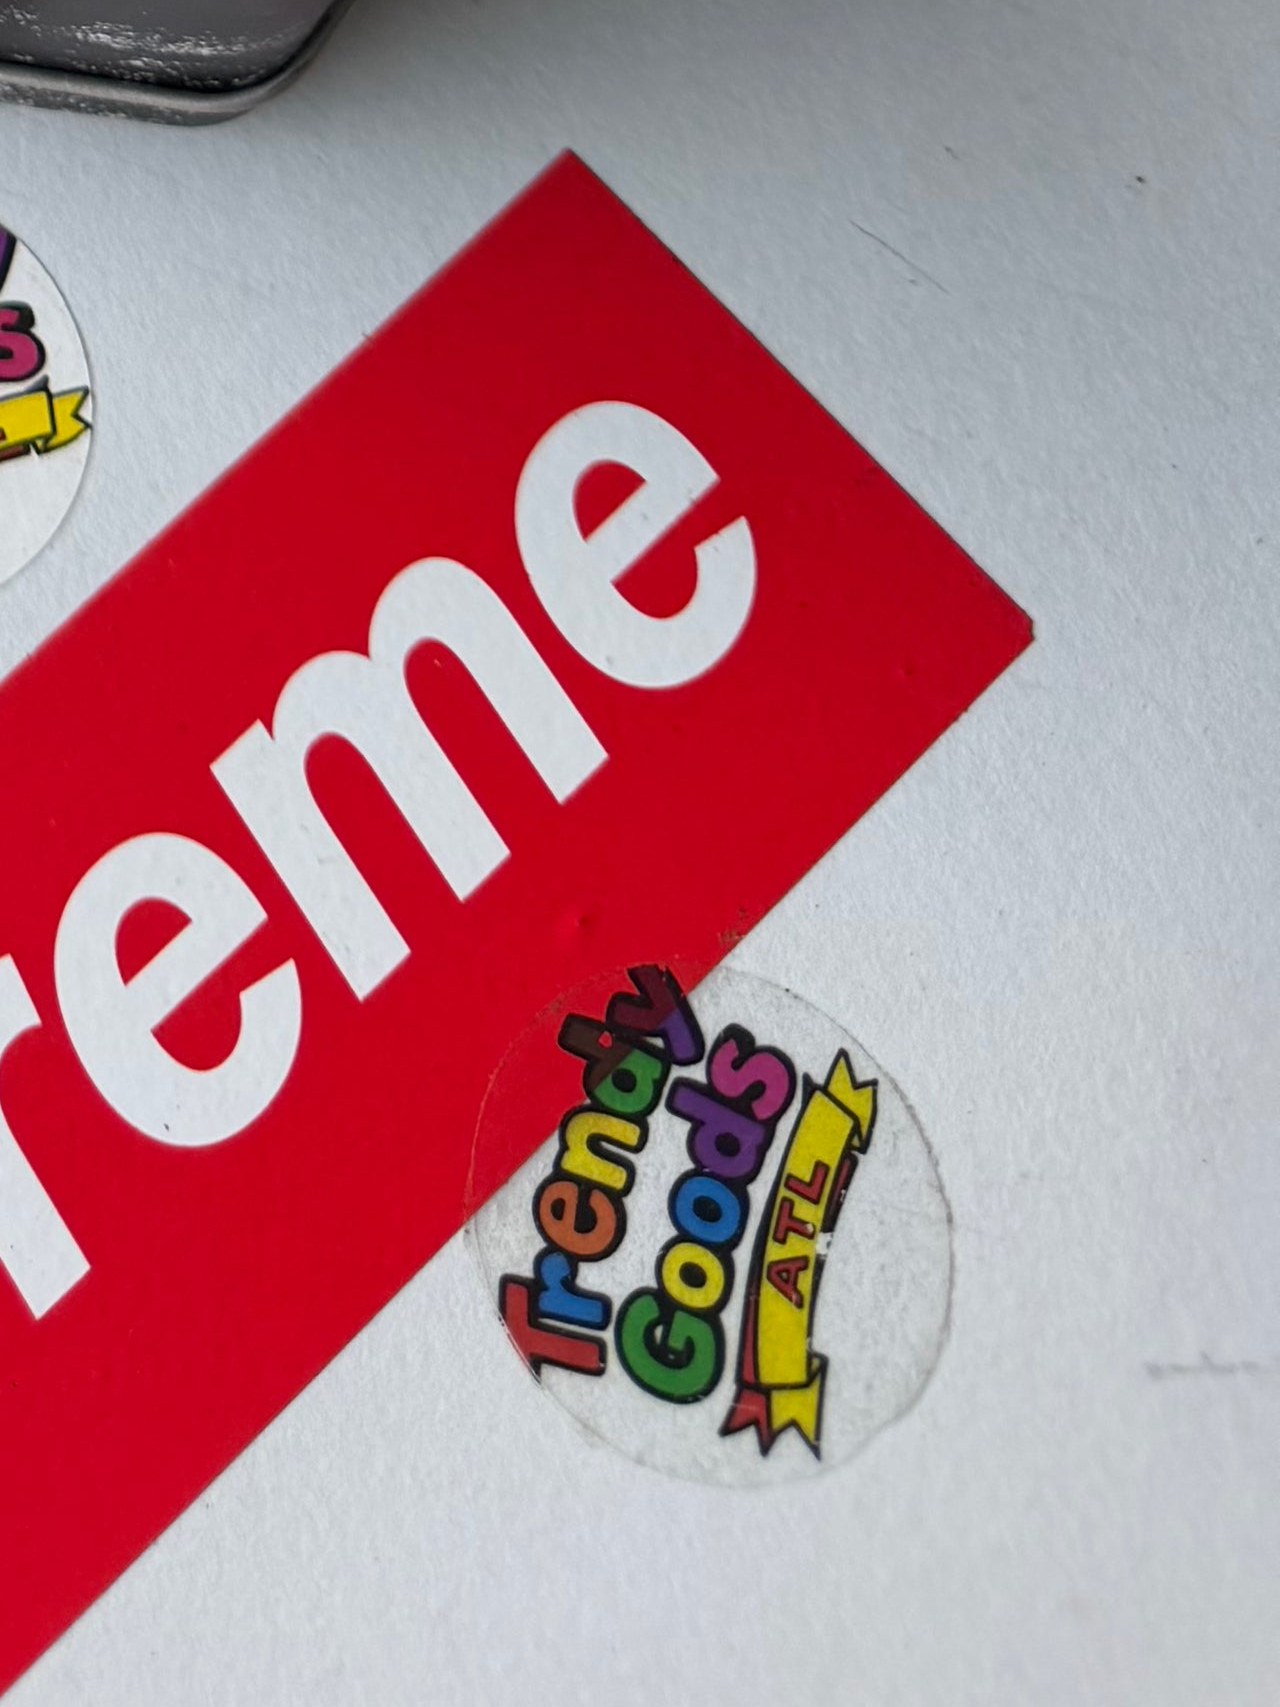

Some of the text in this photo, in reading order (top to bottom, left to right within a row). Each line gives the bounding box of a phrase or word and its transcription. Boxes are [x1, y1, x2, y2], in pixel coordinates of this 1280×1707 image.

[498, 963, 706, 1378] Trendy
[613, 1022, 798, 1405] Goods
[764, 1159, 832, 1310] ATL
